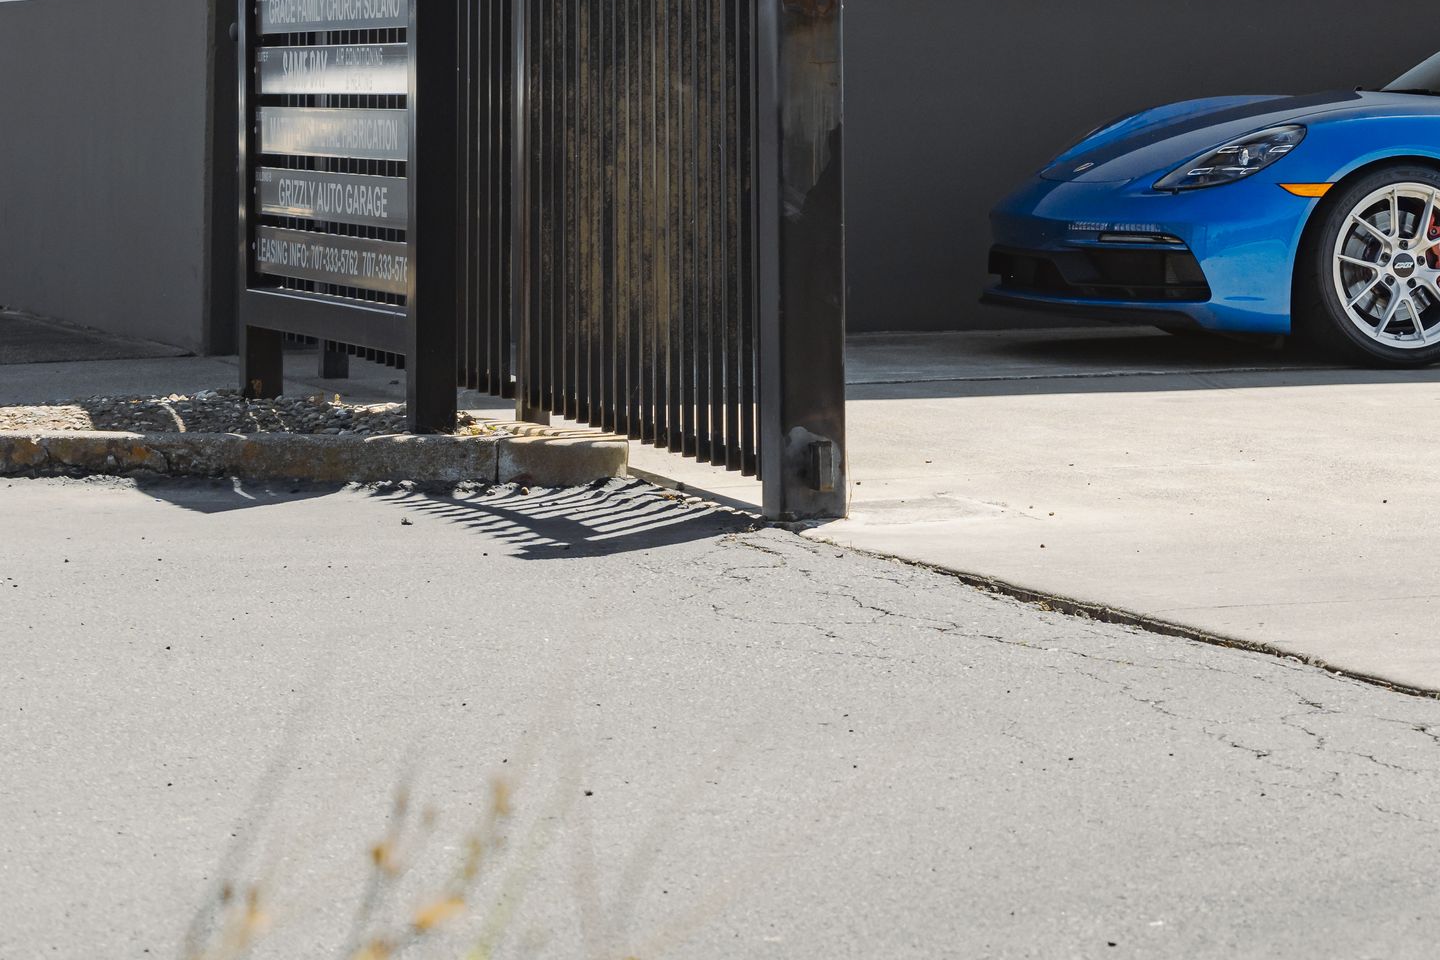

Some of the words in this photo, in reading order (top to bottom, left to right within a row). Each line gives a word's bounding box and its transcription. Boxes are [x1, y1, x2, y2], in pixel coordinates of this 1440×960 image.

[282, 50, 308, 88] SAME
[310, 50, 328, 88] DAY
[342, 119, 398, 151] FABRICATION
[278, 178, 316, 209] GRIZZLY
[316, 181, 343, 213] AUTO
[345, 184, 388, 218] GARAGE
[257, 237, 288, 265] LEASING
[289, 241, 309, 268] INFO:
[310, 245, 358, 276] 707-333-5762
